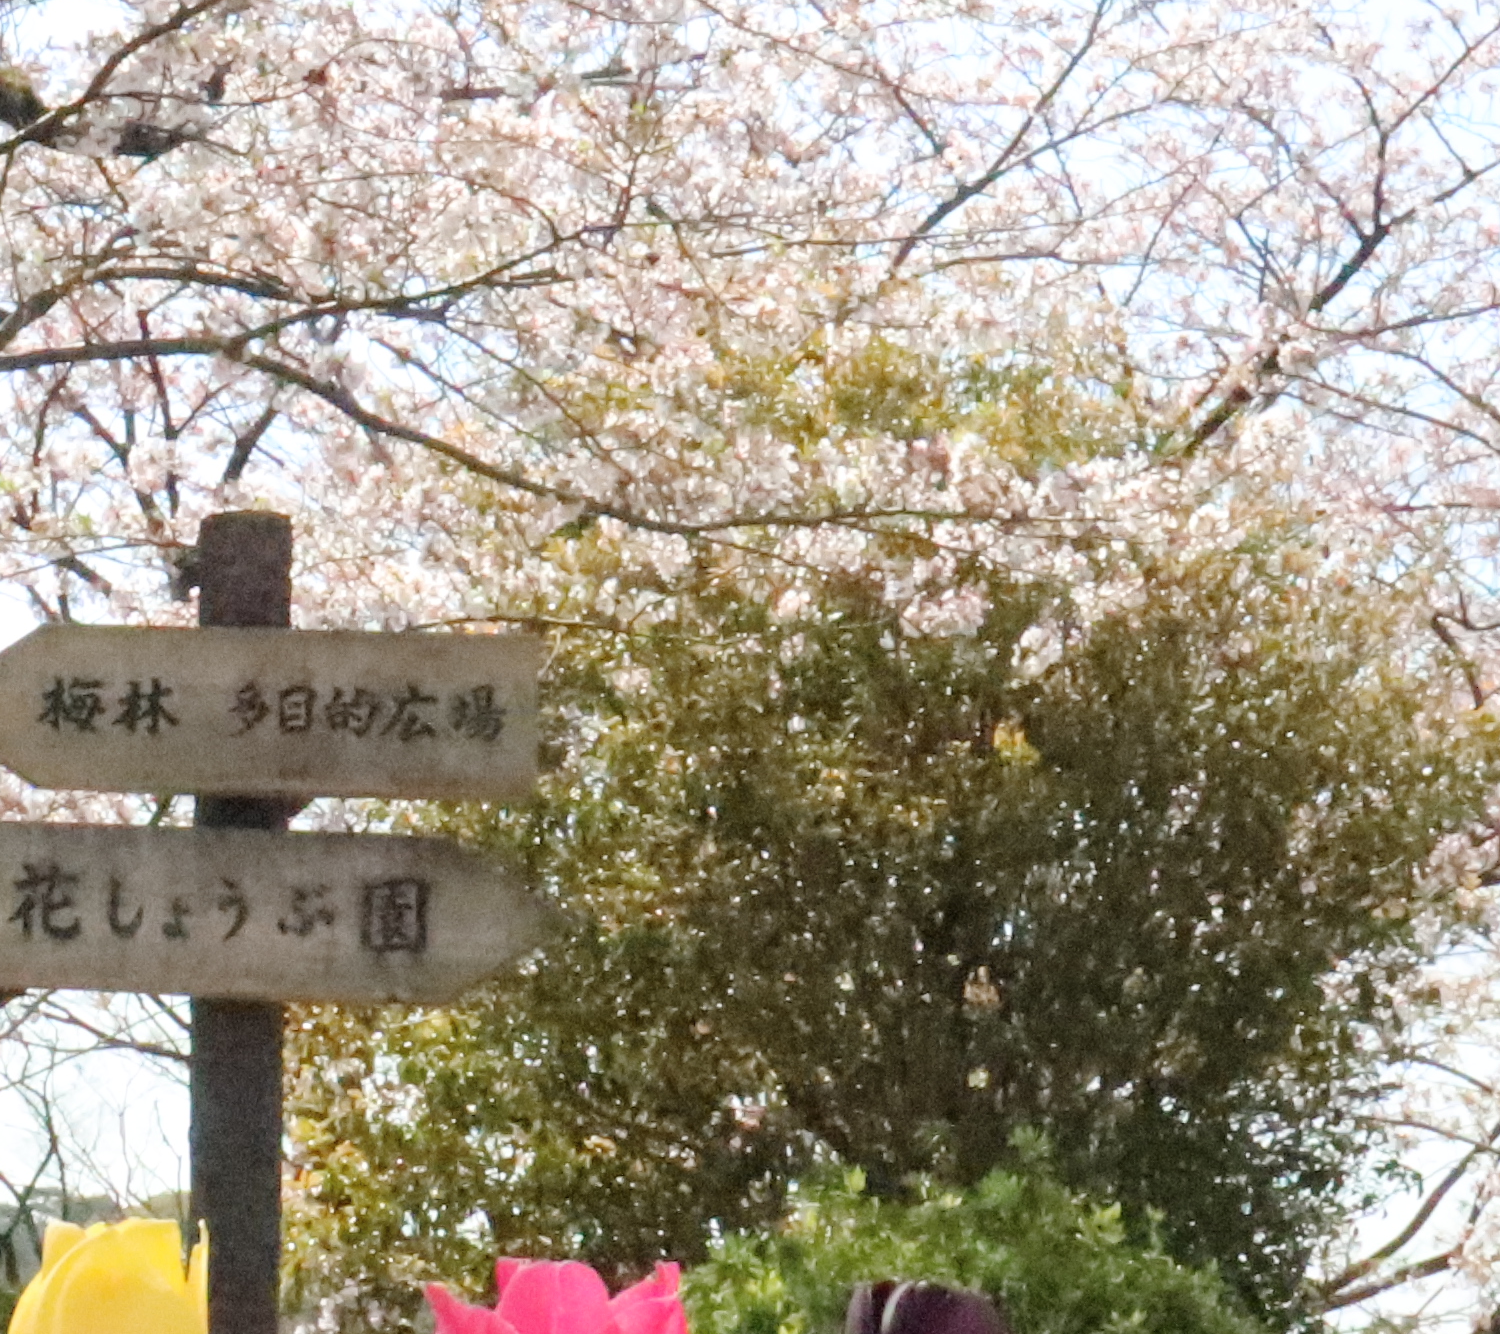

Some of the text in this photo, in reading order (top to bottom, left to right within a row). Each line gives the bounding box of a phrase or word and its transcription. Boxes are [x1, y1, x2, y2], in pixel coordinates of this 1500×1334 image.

[37, 677, 506, 742] 梅林 多目的広場
[8, 864, 430, 954] 花しょうぶ園
